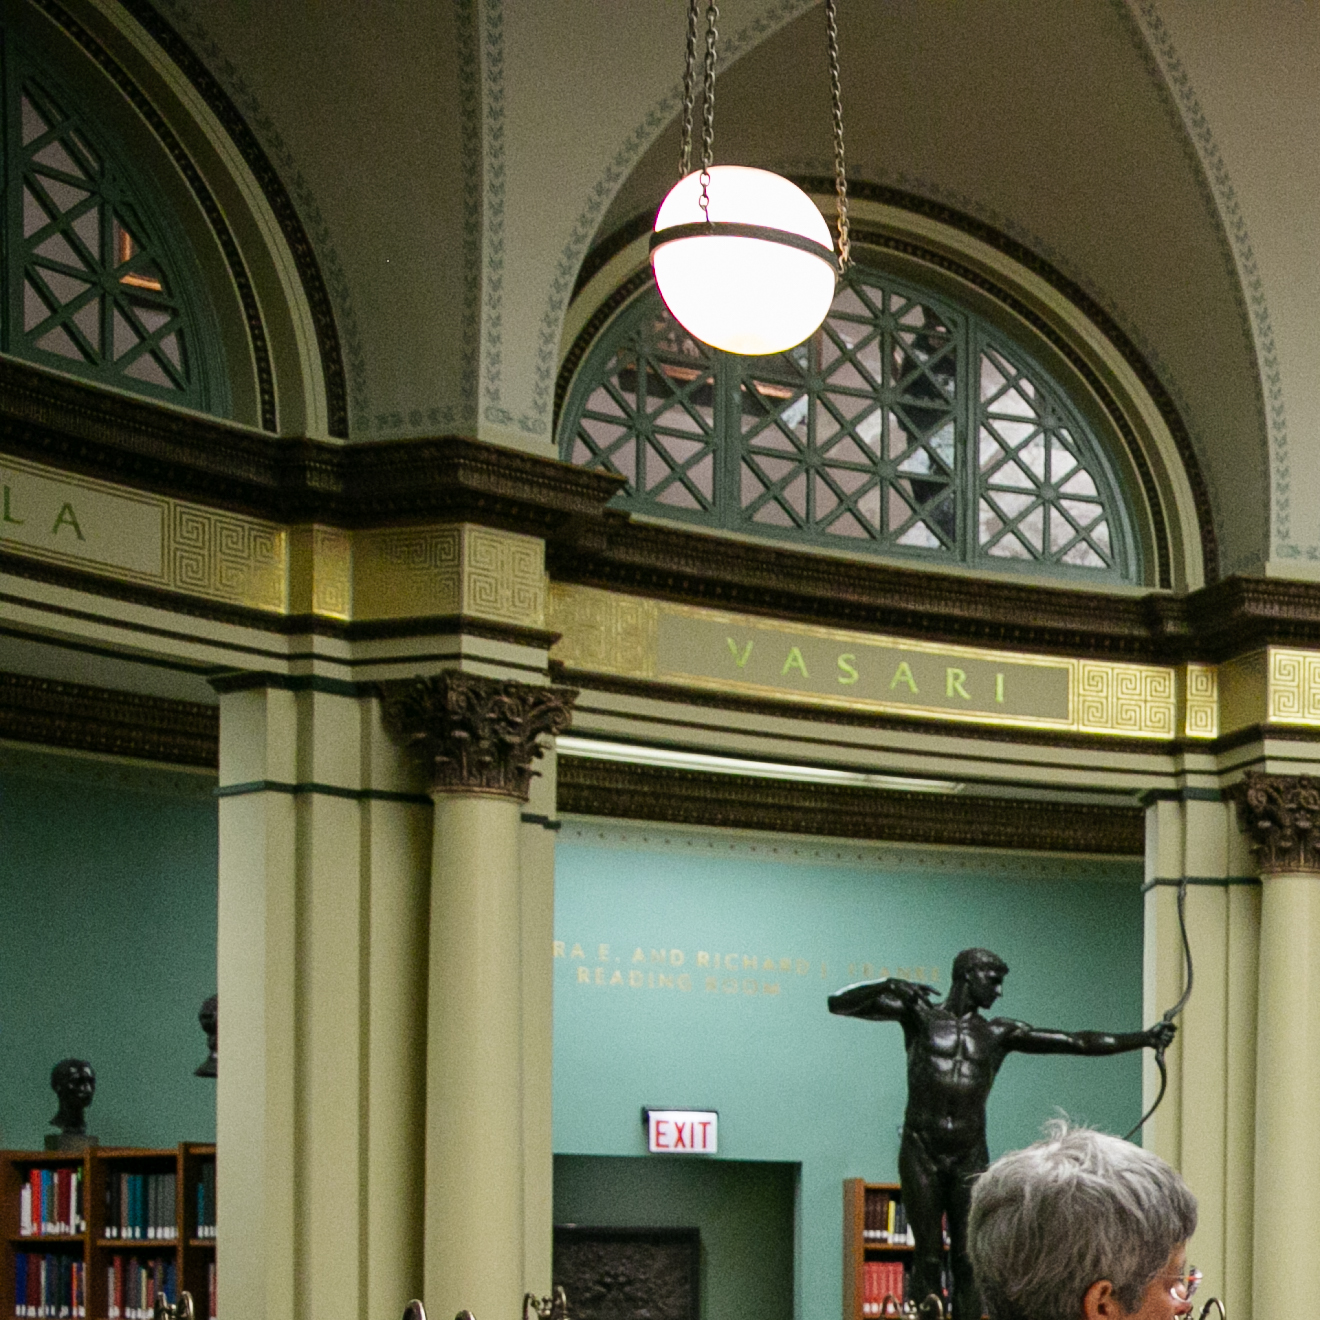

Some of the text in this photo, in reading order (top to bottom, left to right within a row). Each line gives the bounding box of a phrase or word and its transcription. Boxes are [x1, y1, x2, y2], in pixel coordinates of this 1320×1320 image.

[726, 636, 1005, 703] VASARI
[632, 947, 685, 967] AND
[696, 950, 810, 976] RICHARD
[576, 966, 781, 997] READING ROOM
[655, 1120, 711, 1149] EXIT
